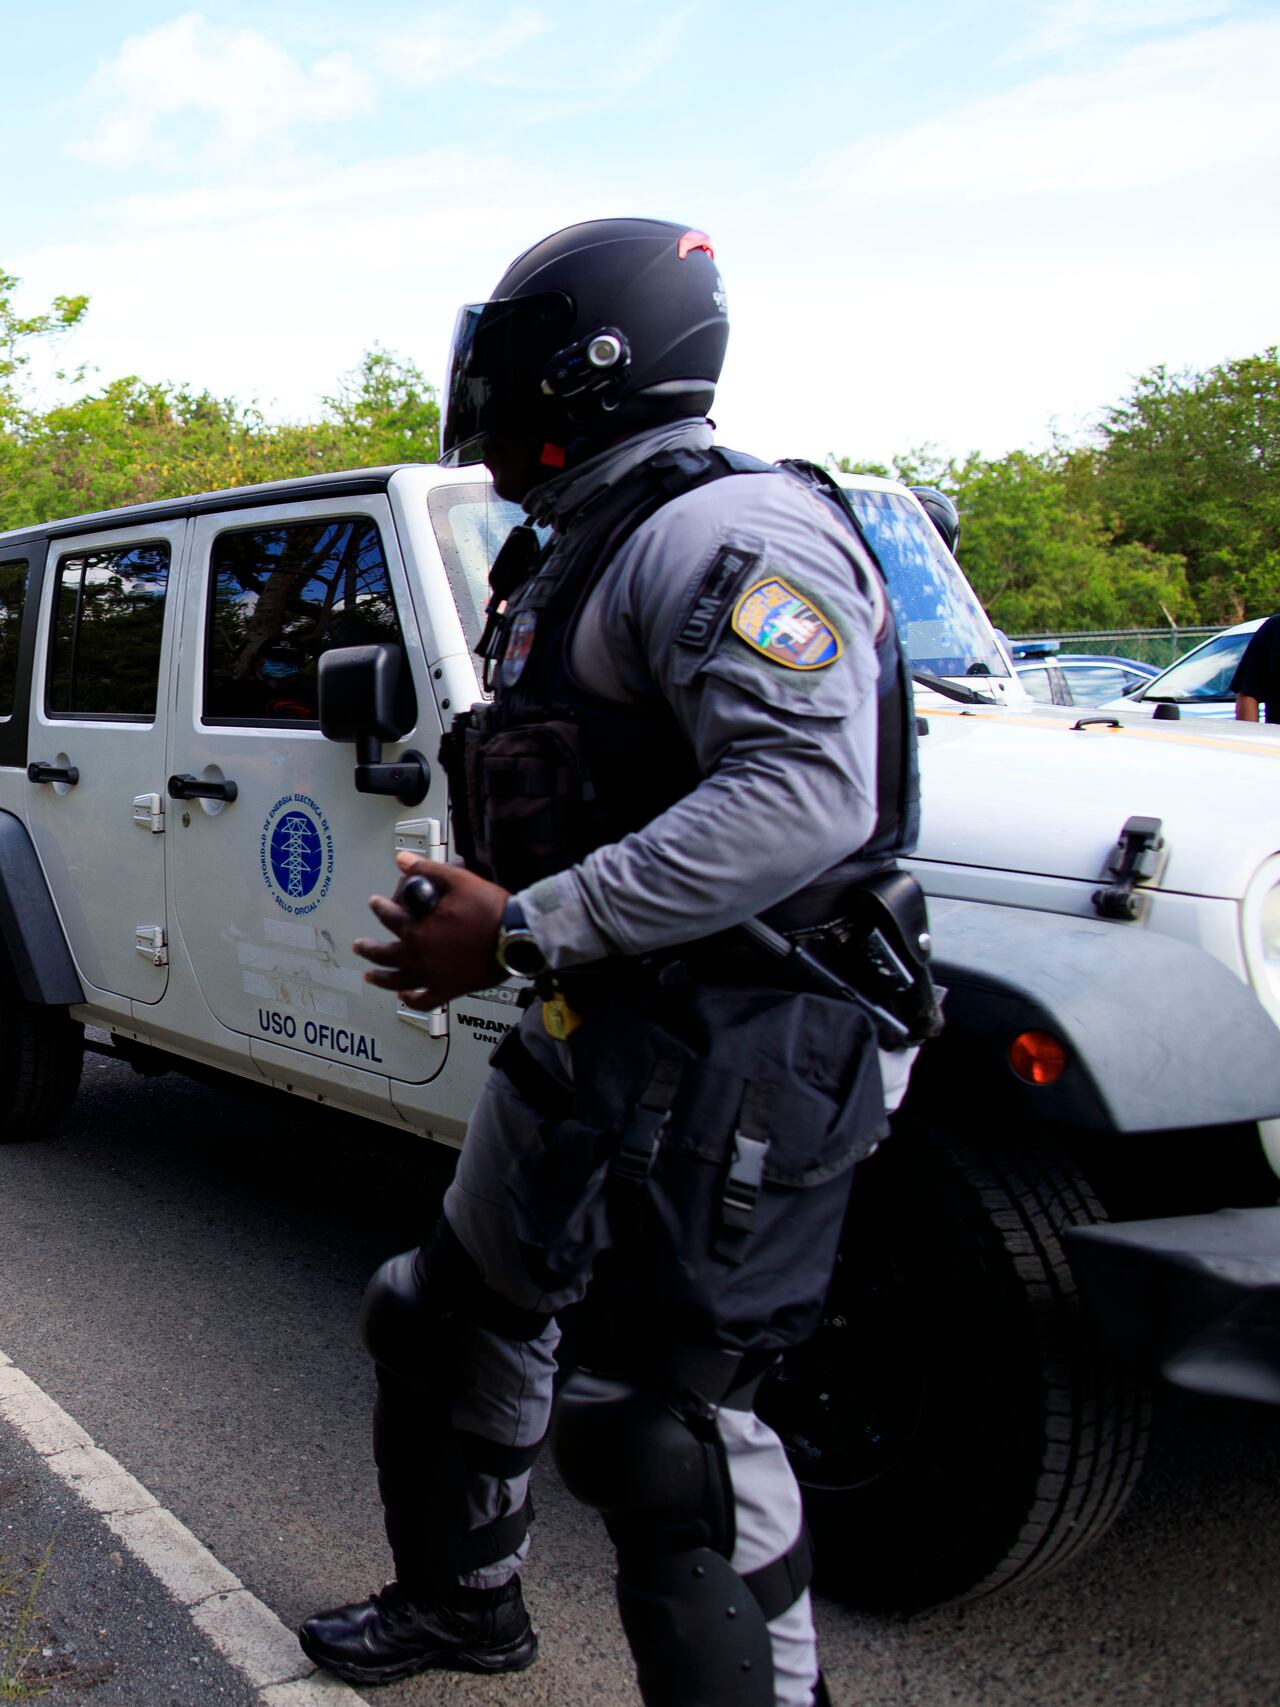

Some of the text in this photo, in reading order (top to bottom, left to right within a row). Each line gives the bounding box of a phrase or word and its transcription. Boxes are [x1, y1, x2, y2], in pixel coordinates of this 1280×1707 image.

[260, 793, 334, 897] AUTORIDAD DE ENERGIA ELECTRICA DE PUERTO RICO
[275, 895, 318, 916] SELLO OFICIAL
[258, 1008, 382, 1063] USO OFICIAL
